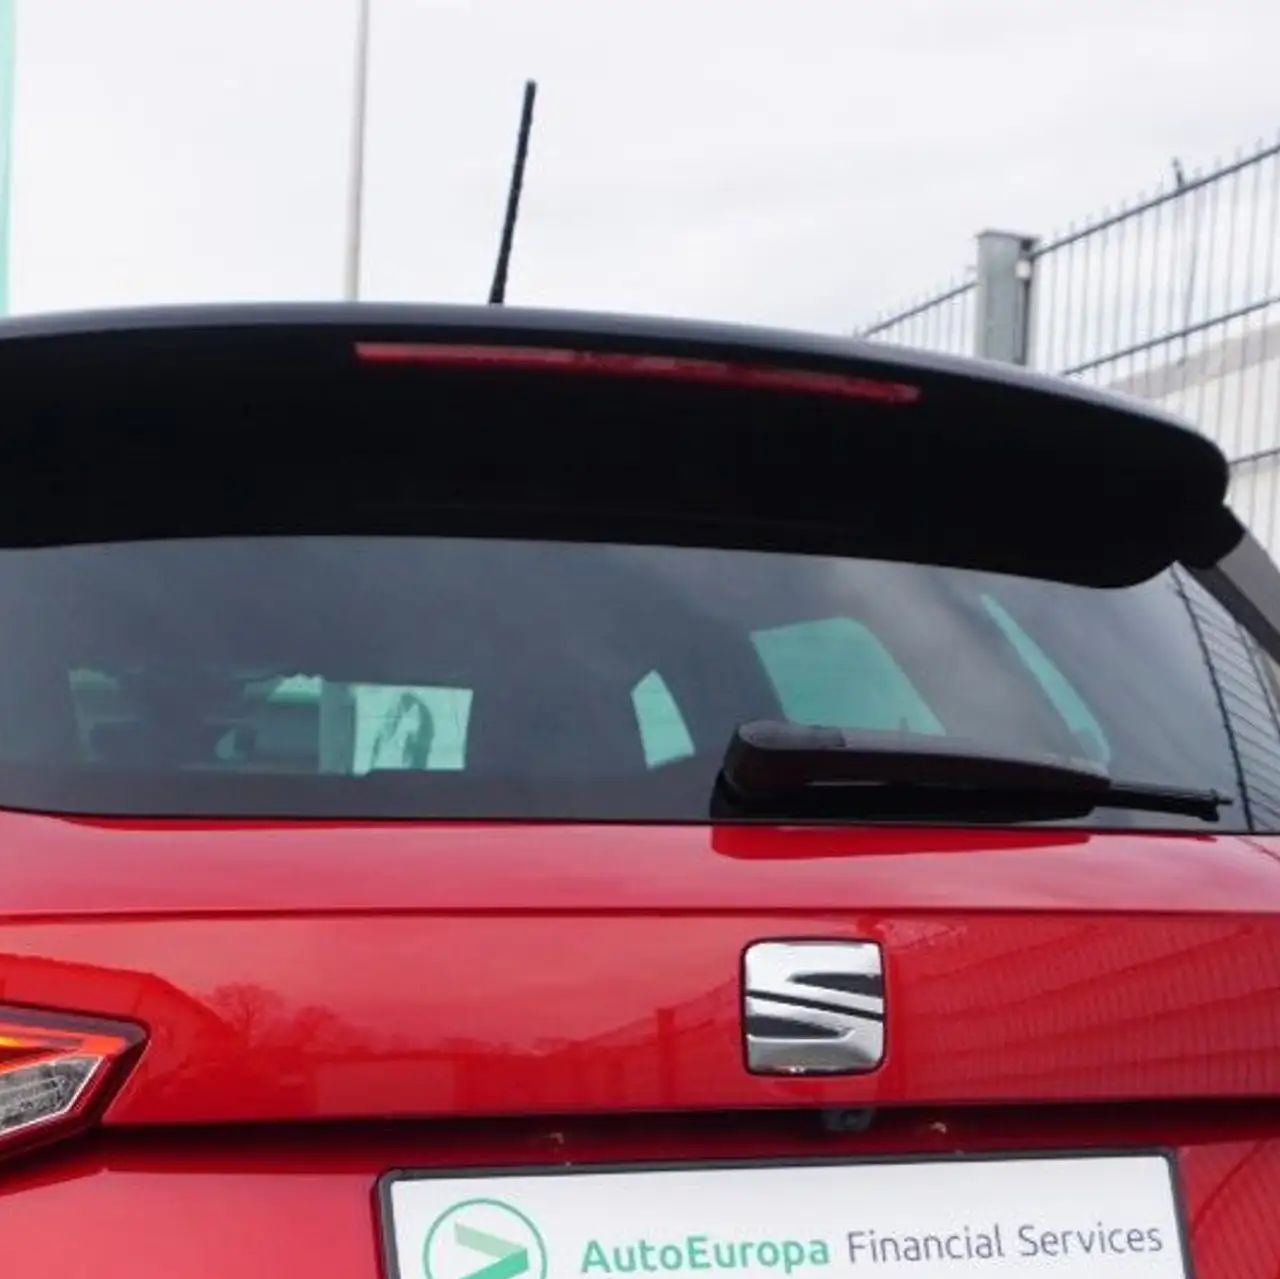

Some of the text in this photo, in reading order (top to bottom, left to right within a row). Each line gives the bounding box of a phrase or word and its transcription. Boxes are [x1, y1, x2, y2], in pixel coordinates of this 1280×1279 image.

[580, 1221, 1164, 1275] AutoEuropa Financial Services
